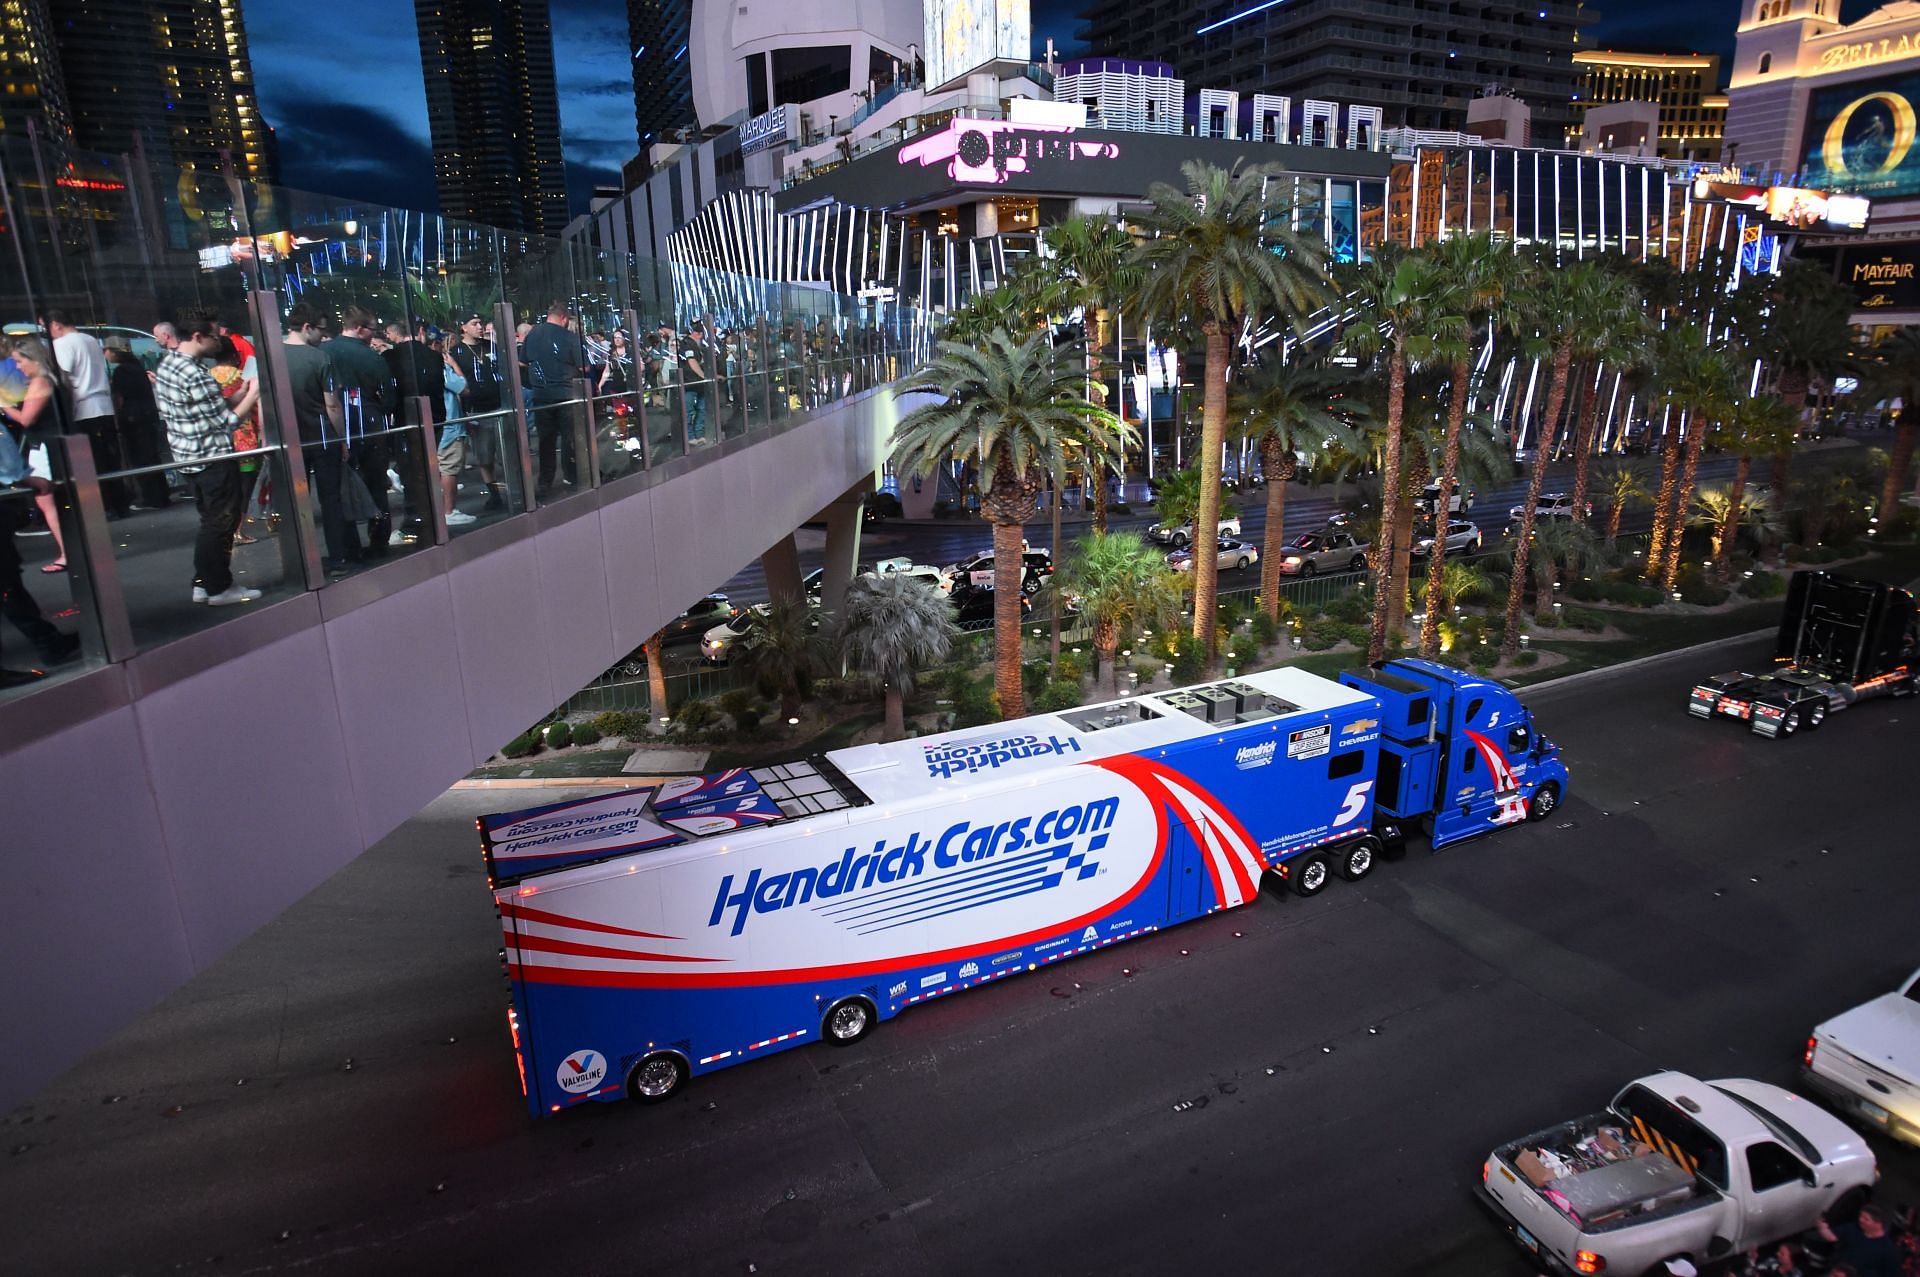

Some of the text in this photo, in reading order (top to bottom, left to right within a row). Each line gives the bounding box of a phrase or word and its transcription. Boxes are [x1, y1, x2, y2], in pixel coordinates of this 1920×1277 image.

[739, 106, 786, 143] MARQUEE
[1852, 263, 1915, 282] MAYFAIR
[1488, 711, 1500, 728] 5
[1339, 733, 1379, 748] CHEVROLET
[928, 736, 1081, 779] Hendrick
[1236, 741, 1277, 763] Hendrick
[725, 780, 747, 794] 5
[736, 797, 759, 811] 5
[1332, 780, 1373, 827] 5
[1262, 825, 1328, 848] HendrickMotorsports.com
[1110, 920, 1133, 930] Acronis
[1035, 938, 1070, 952] CINCINNATI
[889, 980, 907, 995] WIX
[562, 1068, 602, 1088] VALVOLINE
